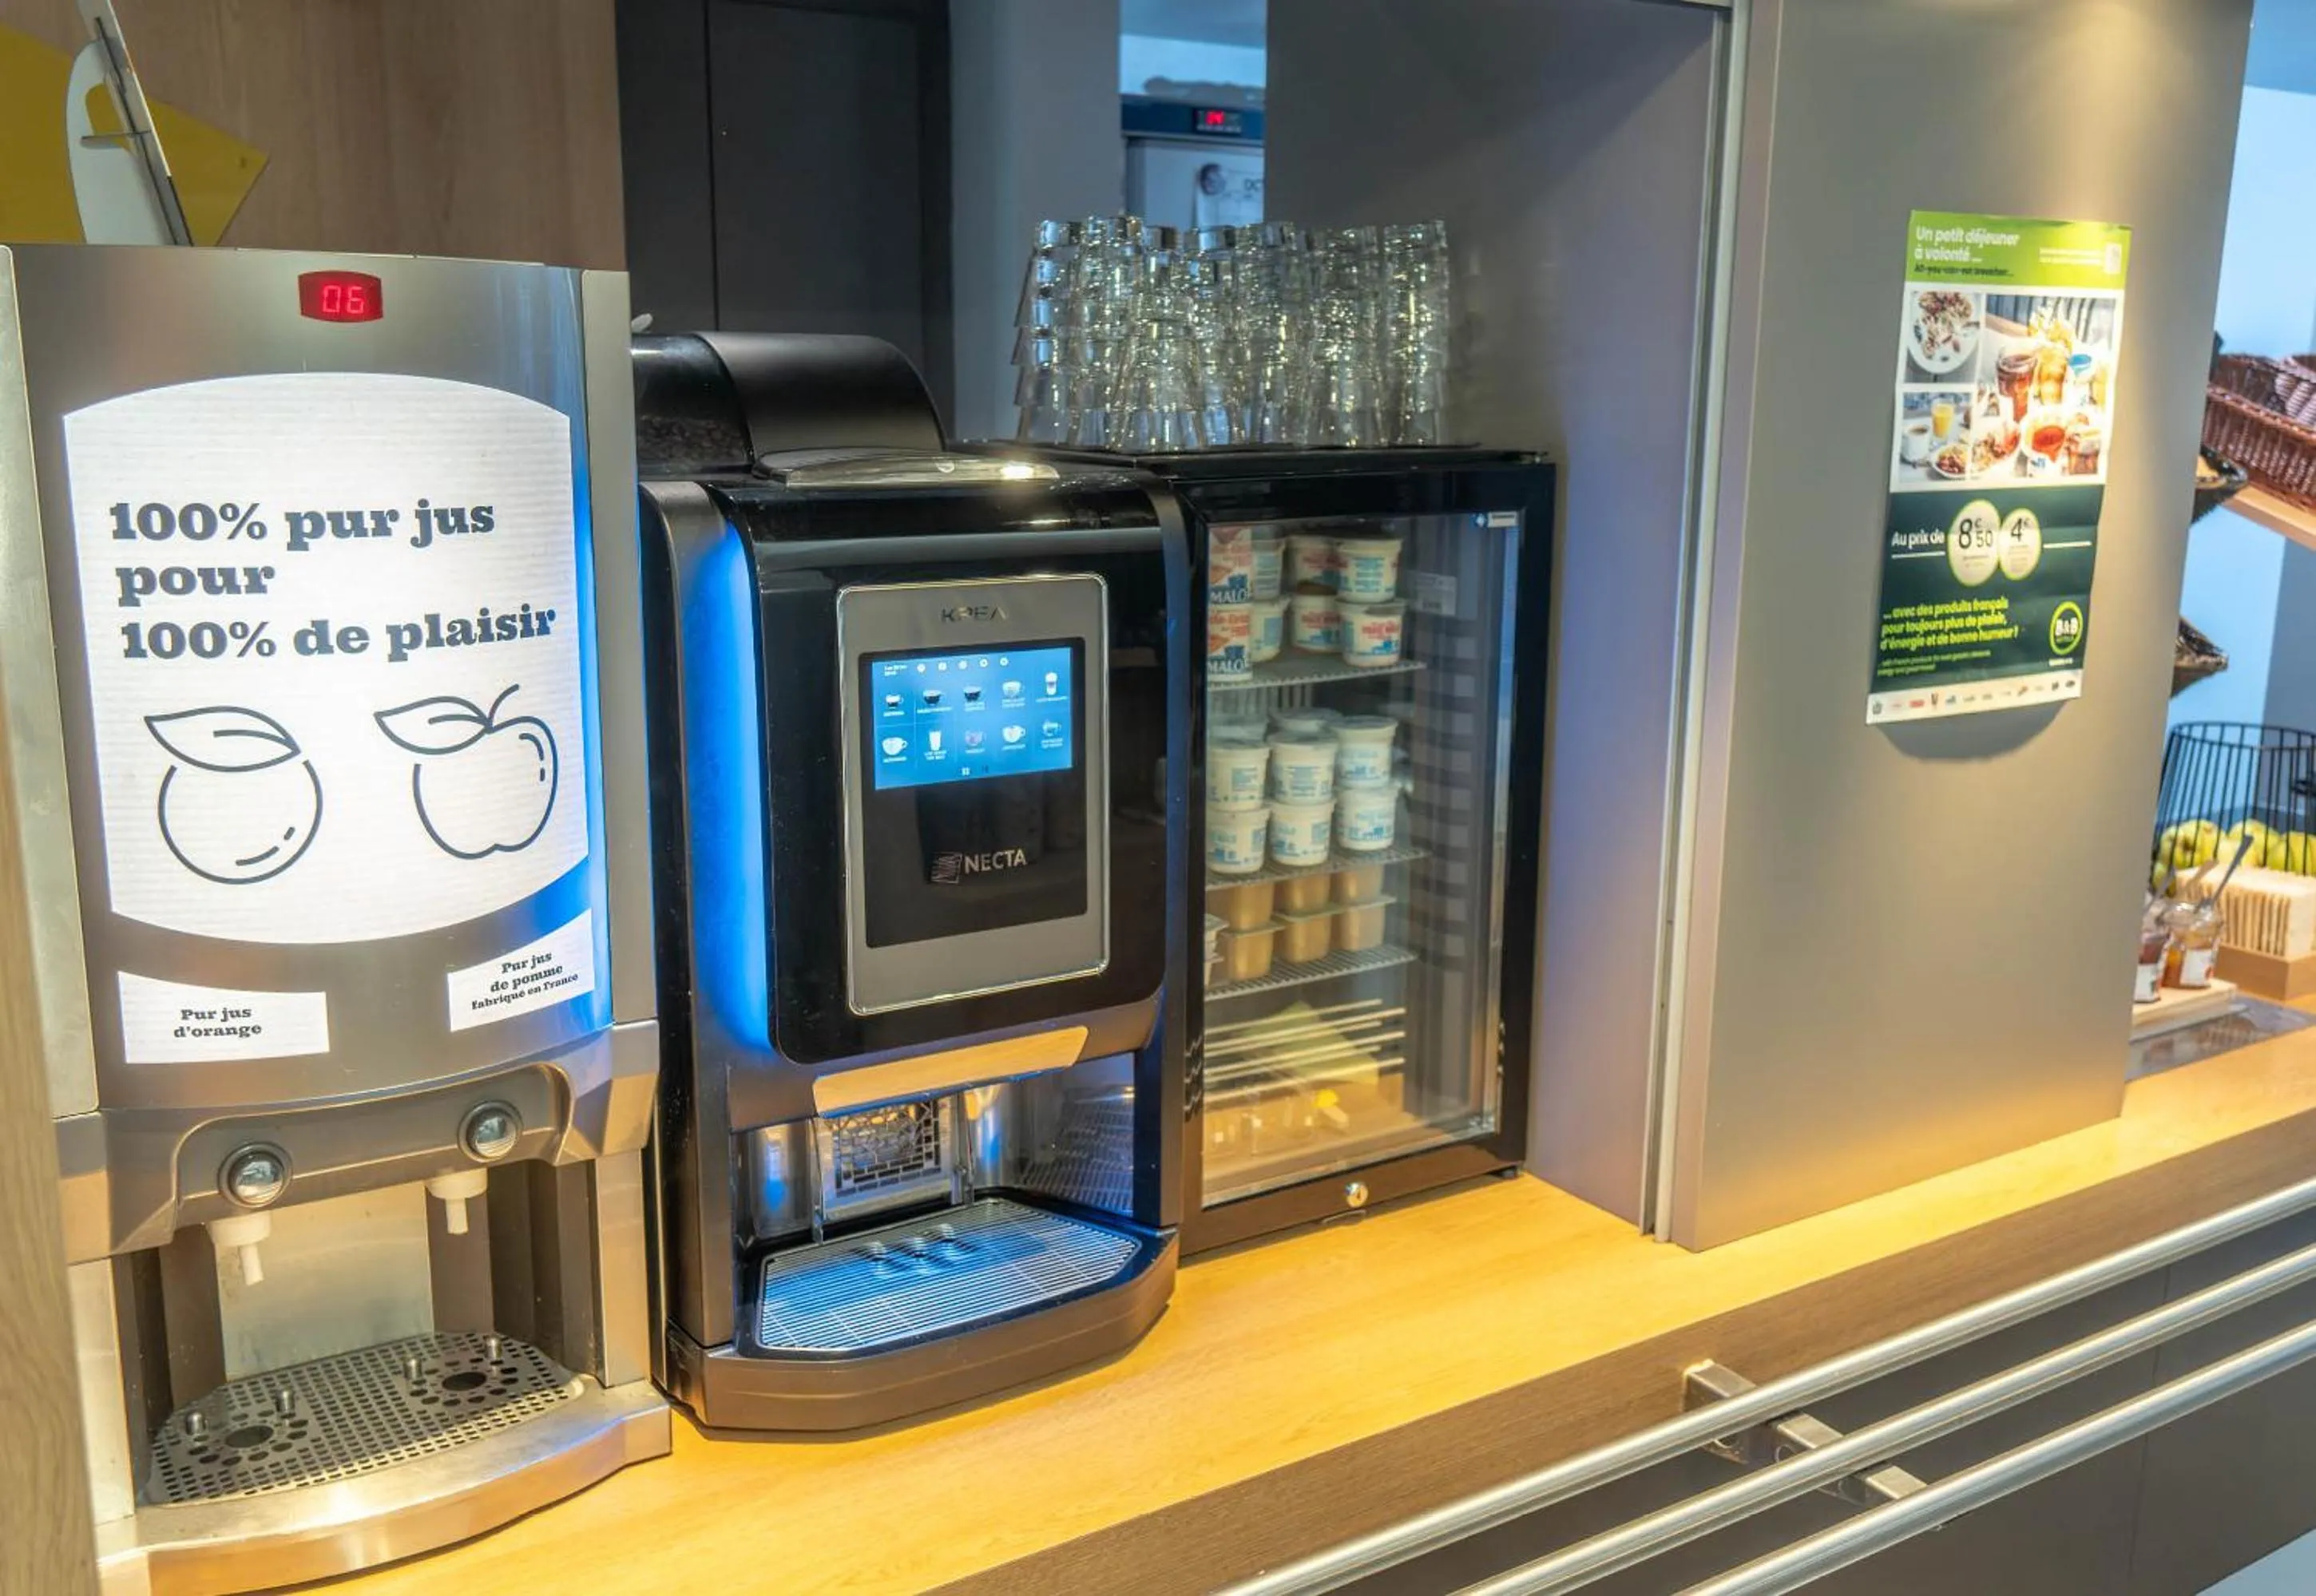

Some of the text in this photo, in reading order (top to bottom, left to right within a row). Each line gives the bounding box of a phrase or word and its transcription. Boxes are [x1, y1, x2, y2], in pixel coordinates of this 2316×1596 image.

[1916, 225, 1933, 241] Un
[1934, 227, 1964, 246] petit
[323, 285, 364, 314] 06
[110, 498, 495, 551] 100% pur jus
[1891, 531, 1906, 547] Au
[1908, 529, 1929, 549] prix
[1929, 529, 1945, 544] de
[115, 565, 276, 607] pour
[1917, 604, 1933, 616] des
[1934, 600, 1972, 618] produits
[121, 603, 557, 662] 100% de plaisir
[1882, 624, 1905, 638] pour
[1906, 619, 1944, 635] toujours
[1945, 616, 1965, 632] plus
[1965, 615, 1977, 628] de
[1949, 630, 1978, 644] bonne
[964, 848, 1028, 874] NECTA
[502, 952, 552, 973] Pur jus
[490, 965, 563, 992] de pomme
[527, 985, 541, 995] en
[543, 972, 578, 990] France
[180, 1007, 252, 1022] Pur jus
[173, 1024, 262, 1039] d'orange
